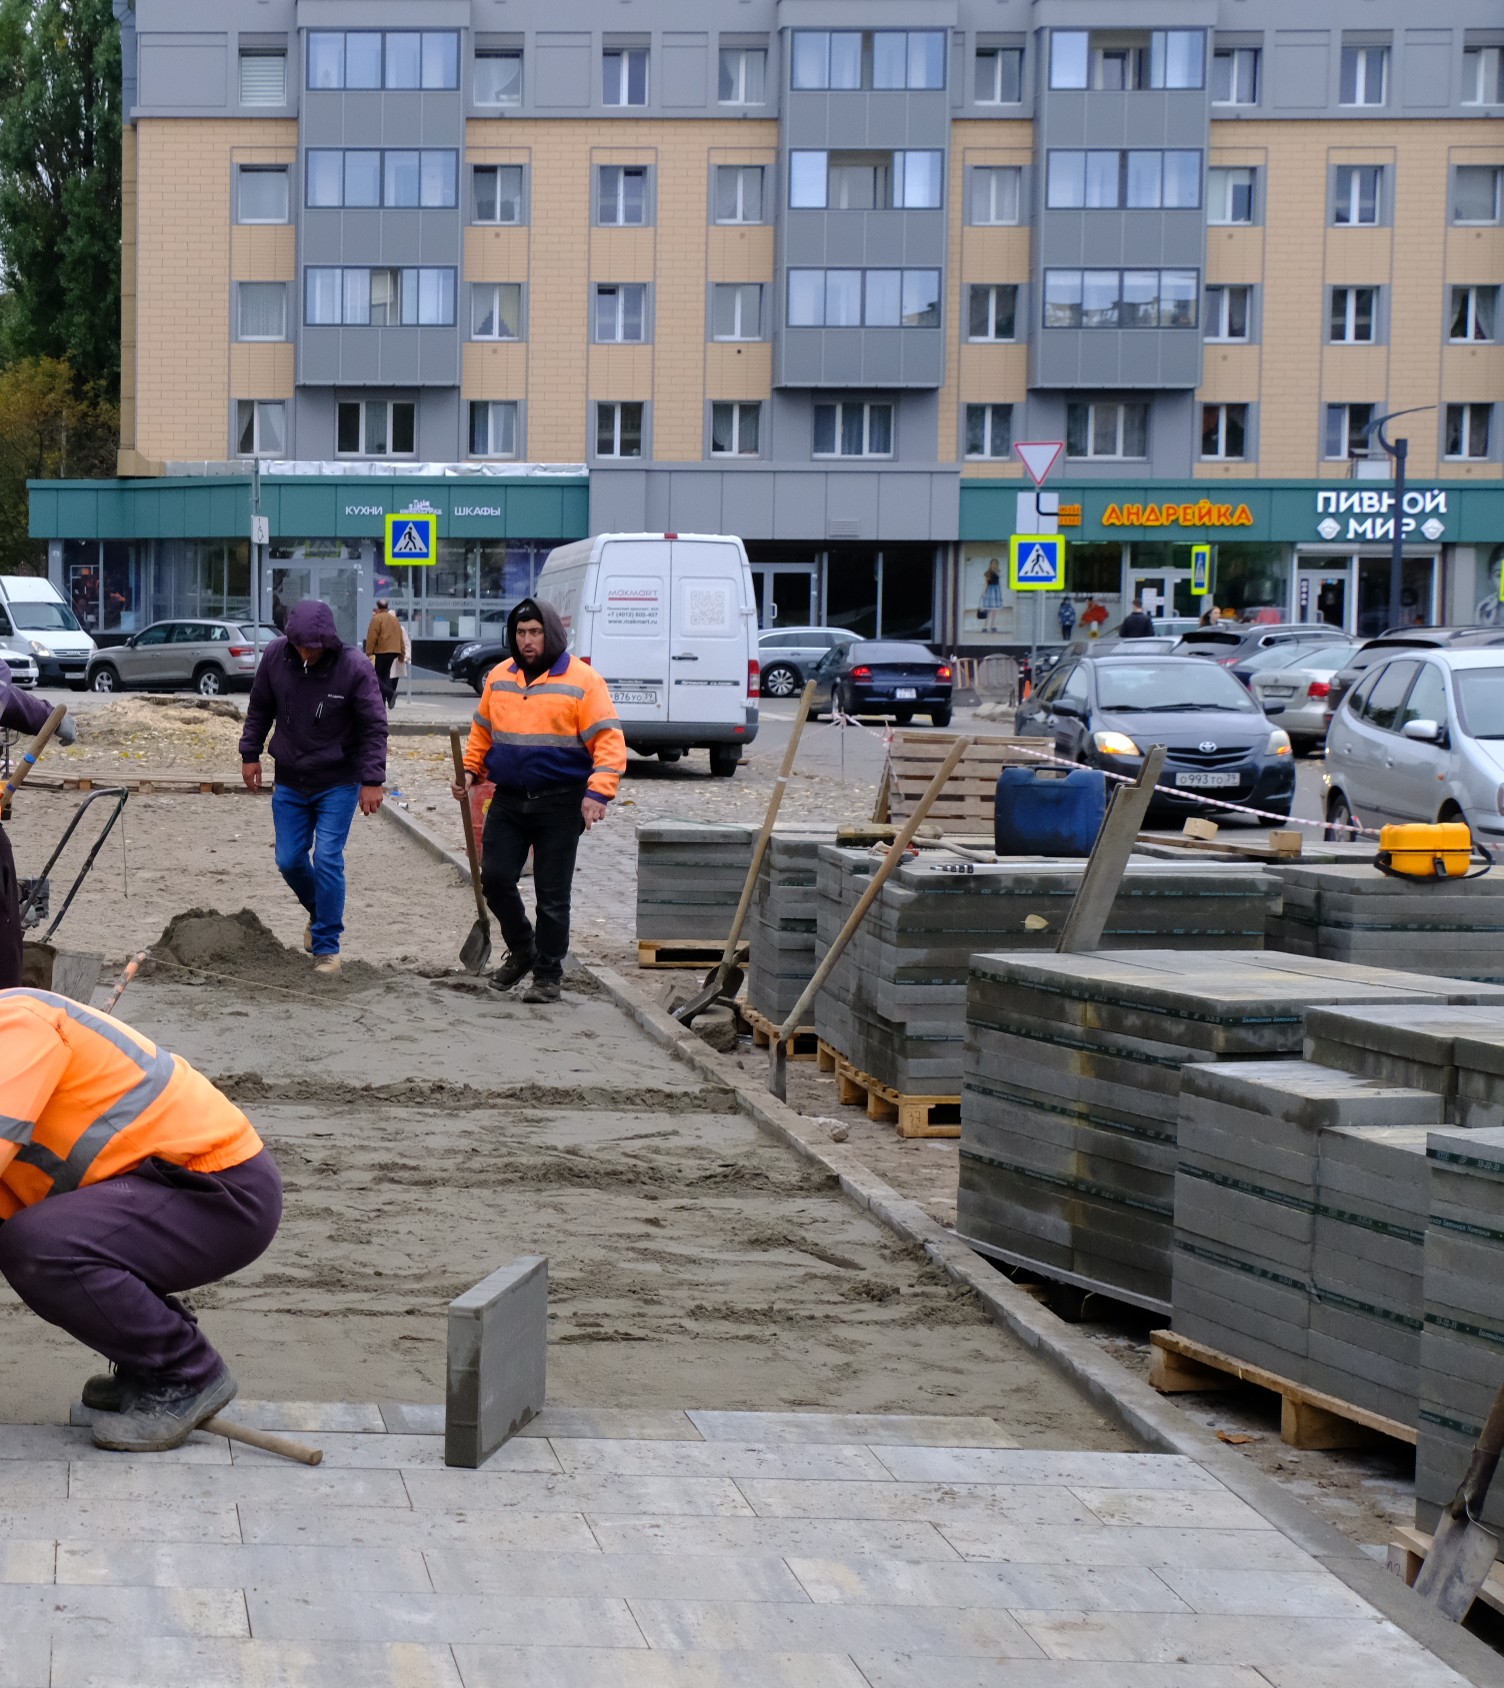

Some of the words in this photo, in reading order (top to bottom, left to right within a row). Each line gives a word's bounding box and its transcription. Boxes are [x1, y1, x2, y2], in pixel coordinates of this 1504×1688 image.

[345, 506, 383, 515] КУХНИ
[454, 507, 501, 516] ШКАФЫ
[1316, 489, 1447, 514] ПИВНОЙ
[1102, 499, 1254, 526] АНДРЕЙКА
[1346, 518, 1417, 539] МИР
